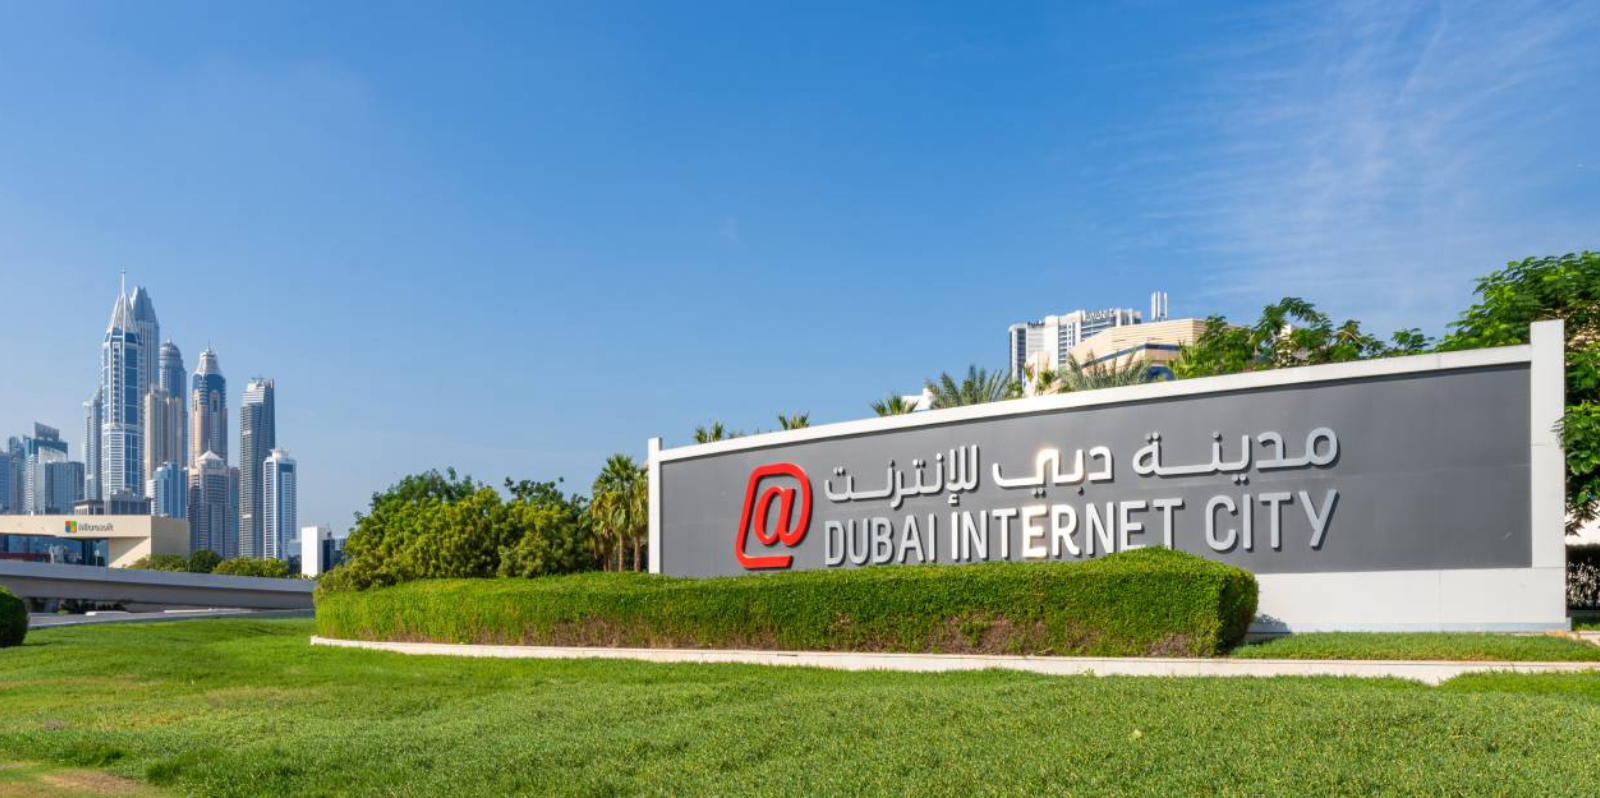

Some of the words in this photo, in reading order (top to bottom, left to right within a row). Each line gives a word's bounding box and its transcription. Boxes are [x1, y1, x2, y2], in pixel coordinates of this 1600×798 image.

[992, 446, 1113, 496] دبي
[1132, 427, 1339, 483] مدينة
[825, 513, 935, 565] DUBAI
[951, 497, 1183, 560] INTERNET
[1205, 489, 1339, 551] CITY
